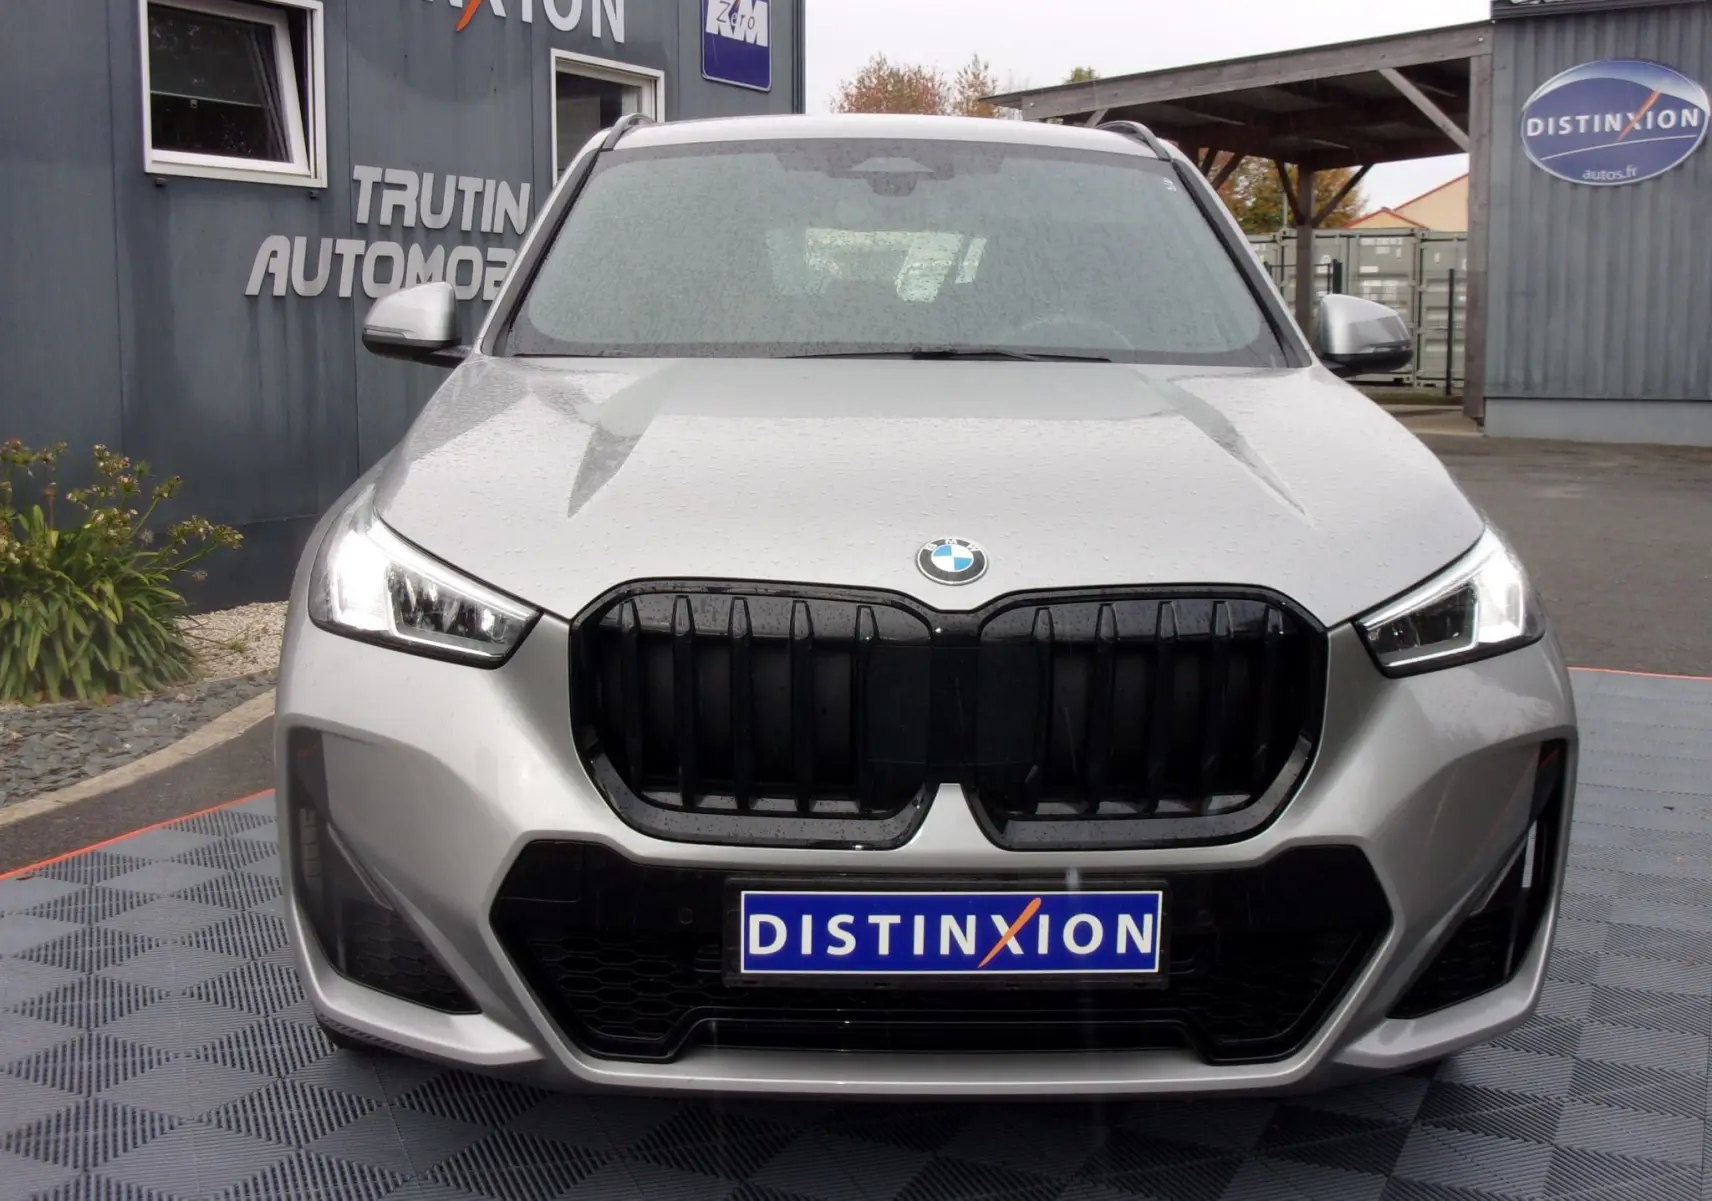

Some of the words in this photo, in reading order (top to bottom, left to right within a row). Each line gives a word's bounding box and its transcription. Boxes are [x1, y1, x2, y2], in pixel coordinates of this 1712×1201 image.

[1527, 92, 1699, 140] DISTINXION
[1582, 164, 1637, 180] autos.fr
[353, 165, 531, 235] TRUTIN
[921, 538, 980, 552] BMW
[748, 897, 1153, 968] DISTINXION
